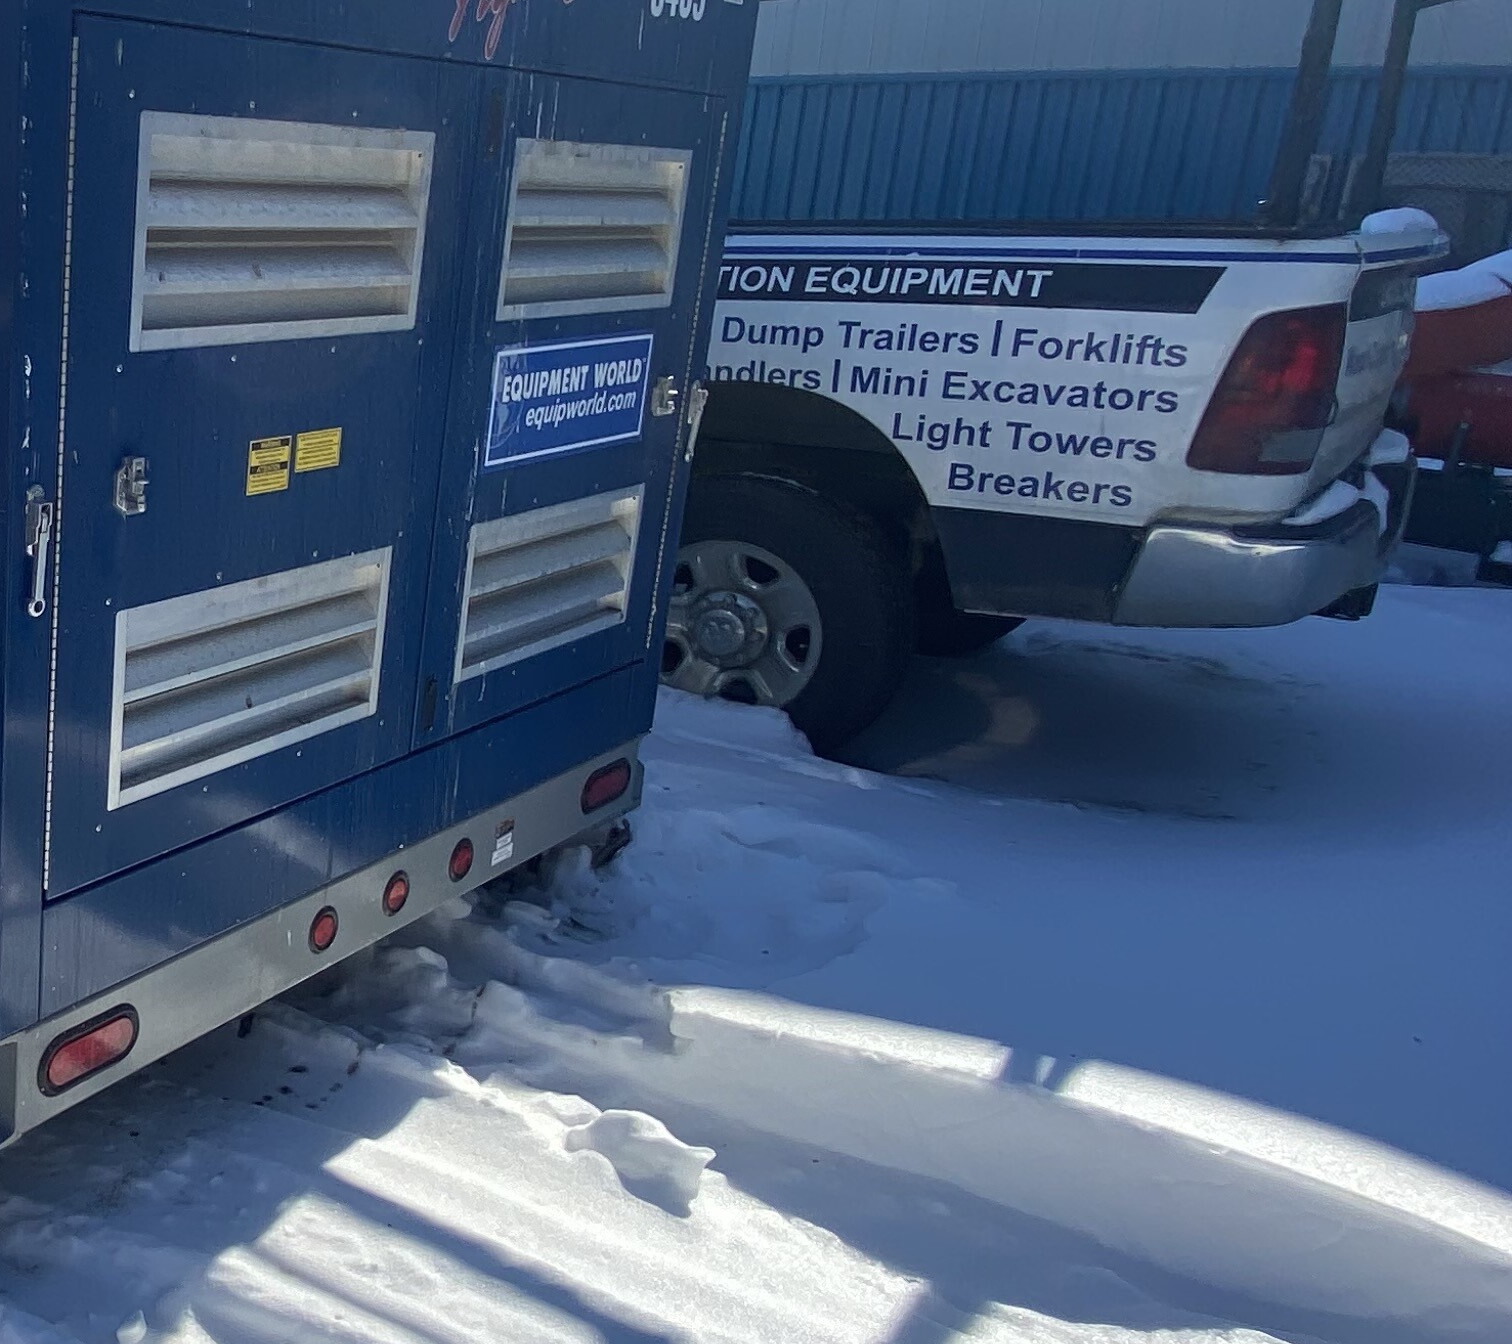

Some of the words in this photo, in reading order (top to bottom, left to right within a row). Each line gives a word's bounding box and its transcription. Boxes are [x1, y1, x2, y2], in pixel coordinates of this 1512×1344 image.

[804, 266, 1053, 297] EQUIPMENT
[721, 316, 825, 353] Dump
[838, 320, 980, 355] Trailers
[1011, 328, 1188, 368] Forklifts
[502, 365, 590, 403] EQUIPMENT
[594, 358, 643, 388] WORLD
[850, 366, 929, 397] Mini
[941, 370, 1180, 414] Excavators
[525, 390, 637, 430] equipworld.com
[892, 412, 992, 452] Light
[1005, 420, 1158, 462] Towers
[947, 462, 1133, 507] Breakers
